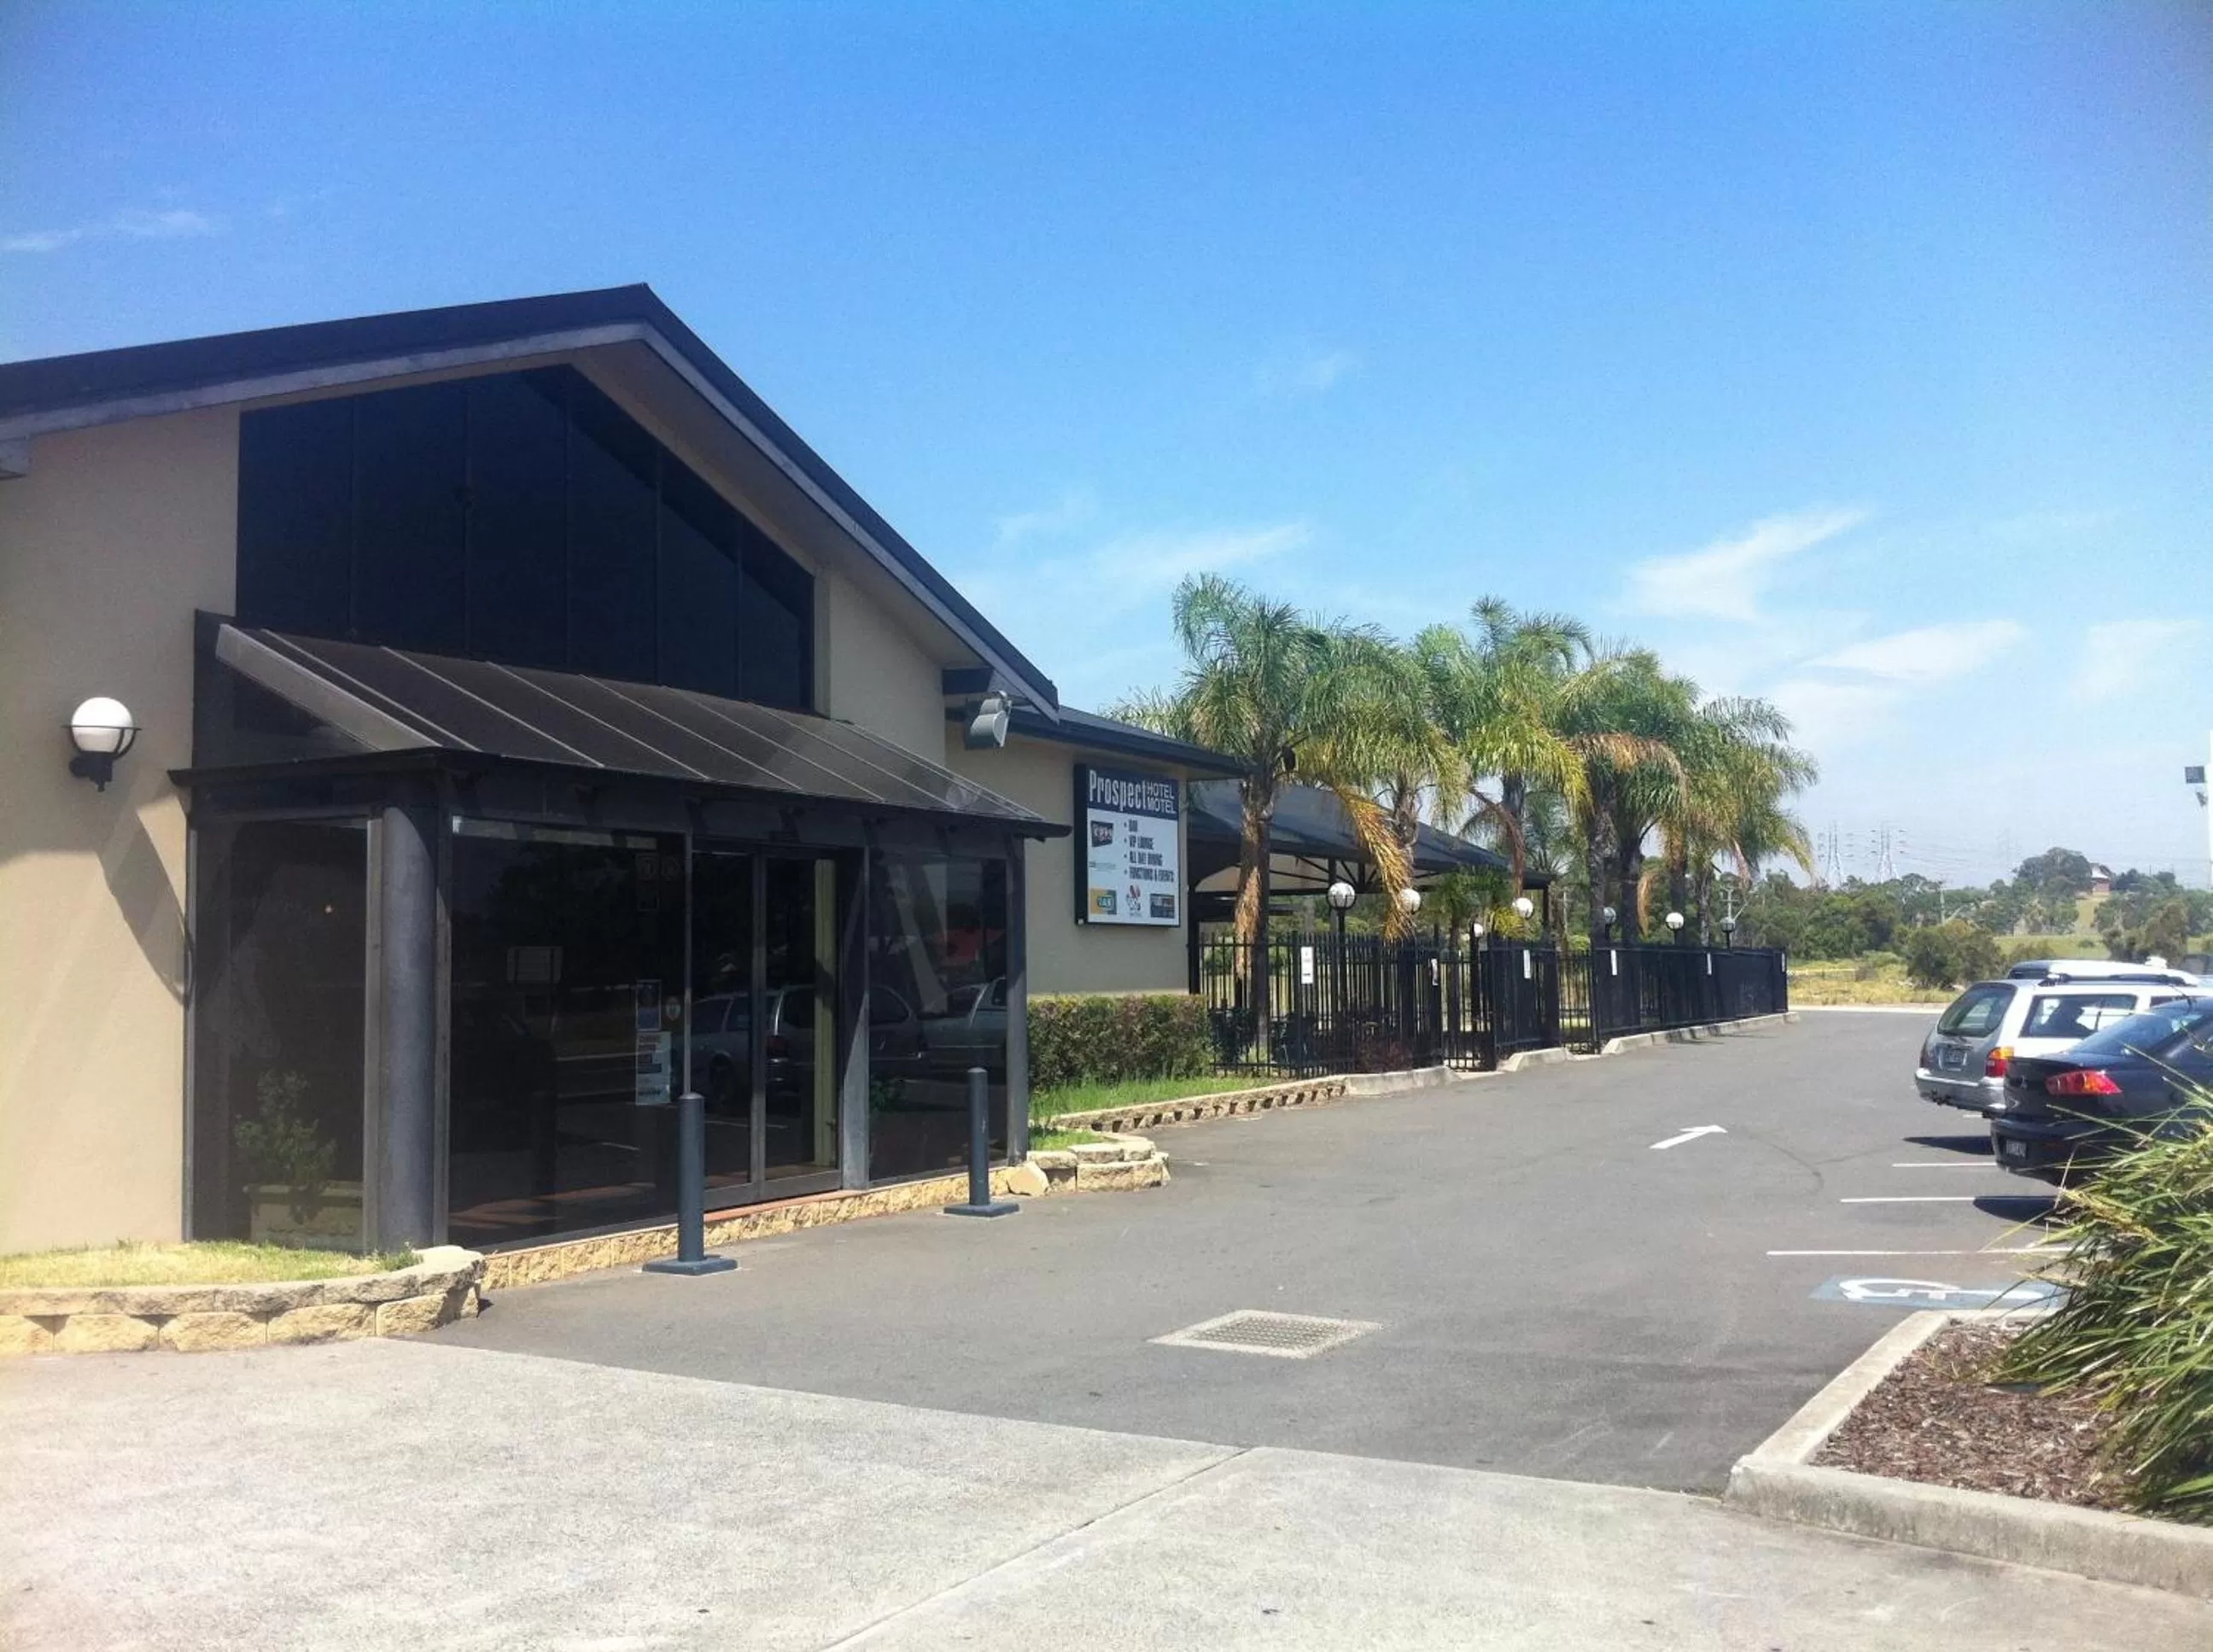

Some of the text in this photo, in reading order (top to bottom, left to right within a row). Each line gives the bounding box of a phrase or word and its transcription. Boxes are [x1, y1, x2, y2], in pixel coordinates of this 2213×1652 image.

[1089, 769, 1147, 812] Prospect
[1147, 781, 1175, 799] HOTEL
[1147, 797, 1177, 814] MOTEL
